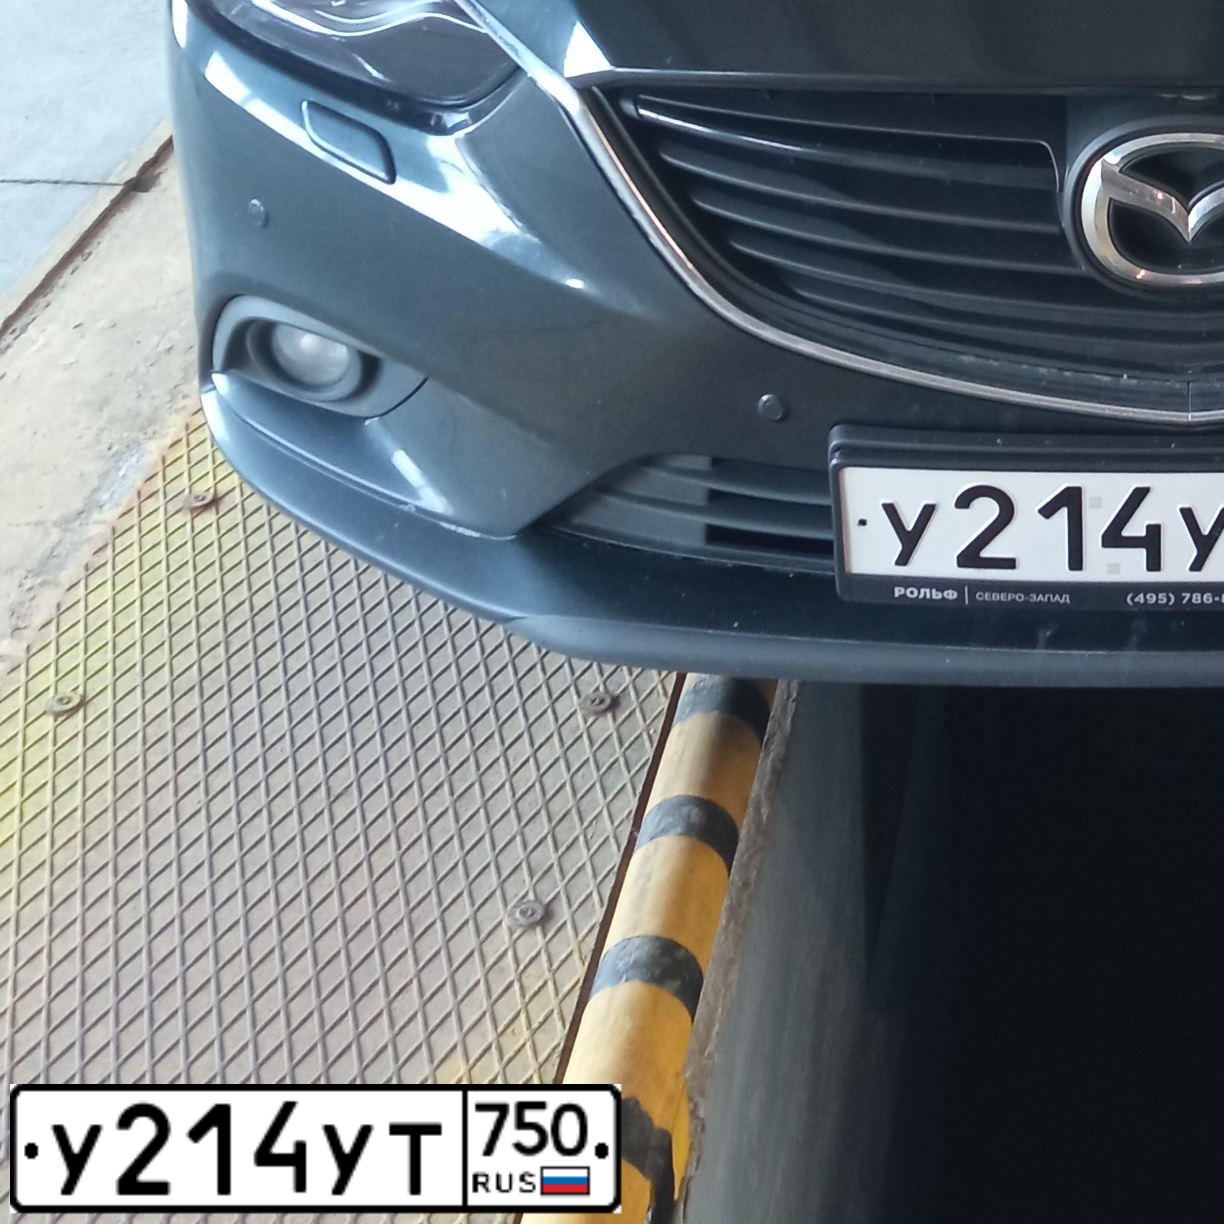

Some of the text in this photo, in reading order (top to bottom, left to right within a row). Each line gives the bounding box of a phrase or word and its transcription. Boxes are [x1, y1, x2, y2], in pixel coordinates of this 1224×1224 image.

[893, 586, 1071, 605] РОЛЬФ СЕВЕРО-ЗАПАД
[1126, 592, 1176, 606] (495)
